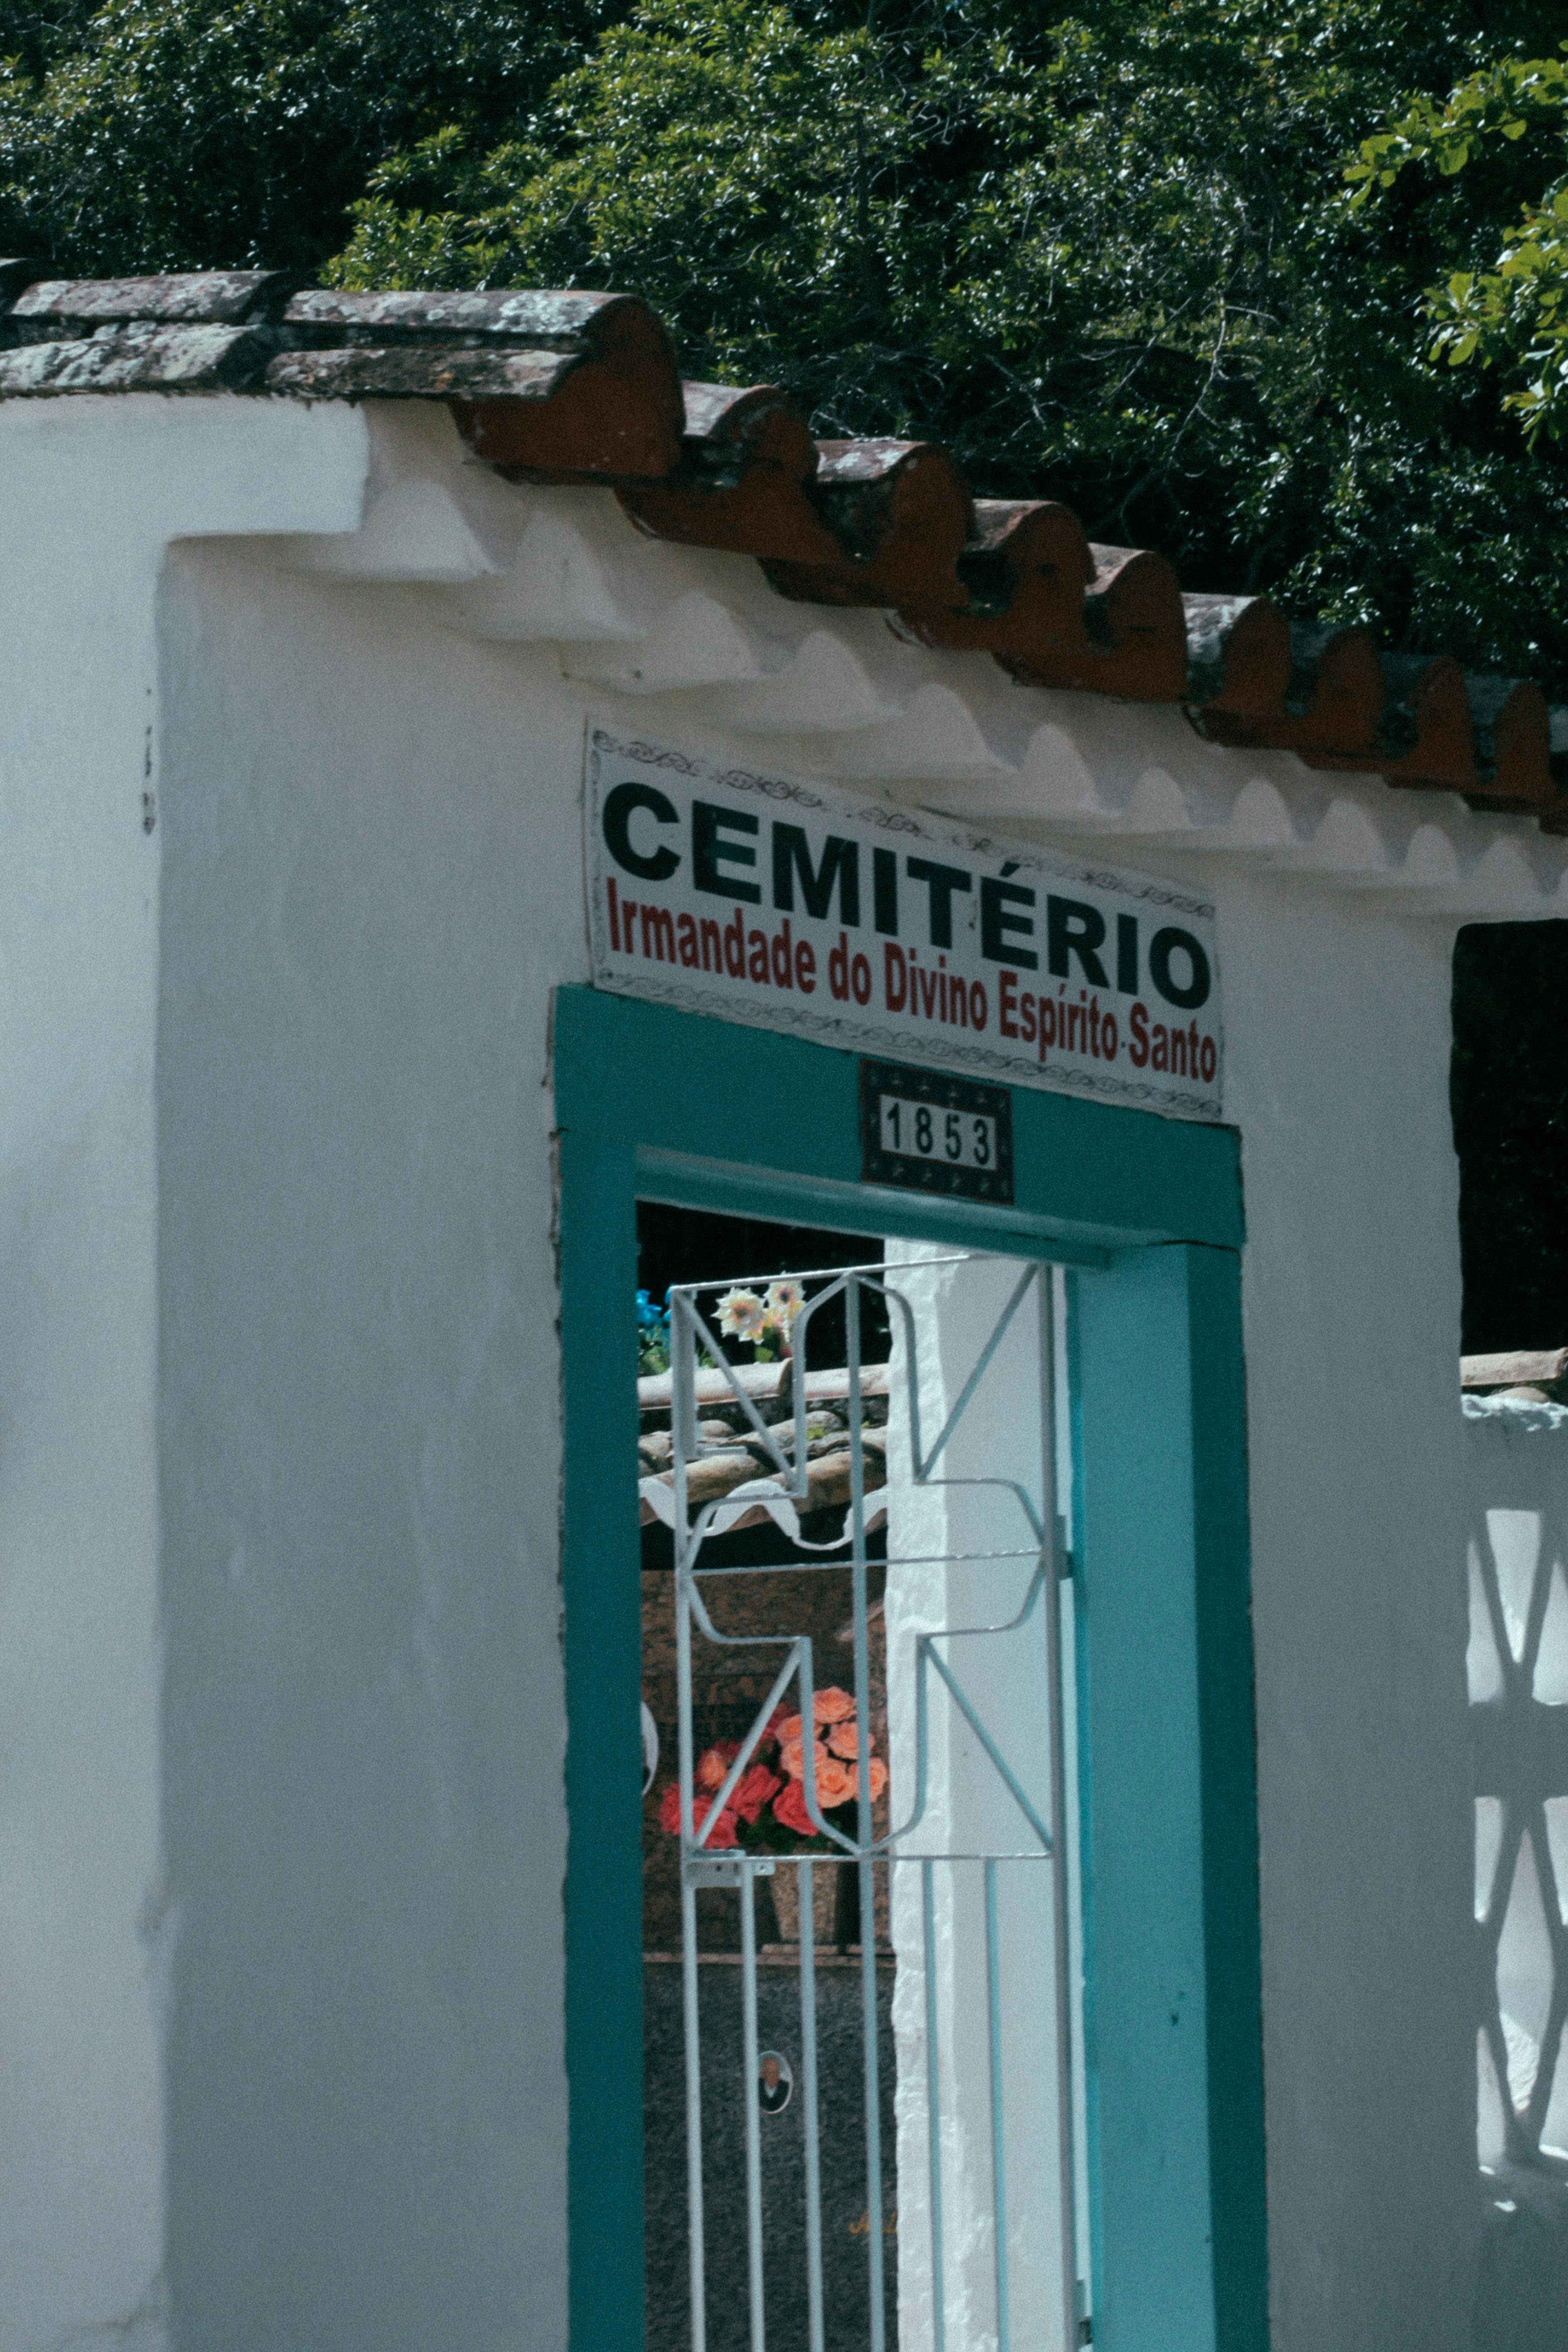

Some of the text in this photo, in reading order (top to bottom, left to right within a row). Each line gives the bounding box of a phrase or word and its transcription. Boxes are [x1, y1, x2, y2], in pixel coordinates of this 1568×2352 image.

[603, 782, 1210, 1010] CEMITÉRIO
[607, 876, 1217, 1083] Irmandade do Divino Espírito Santo
[887, 1102, 990, 1165] 1853
